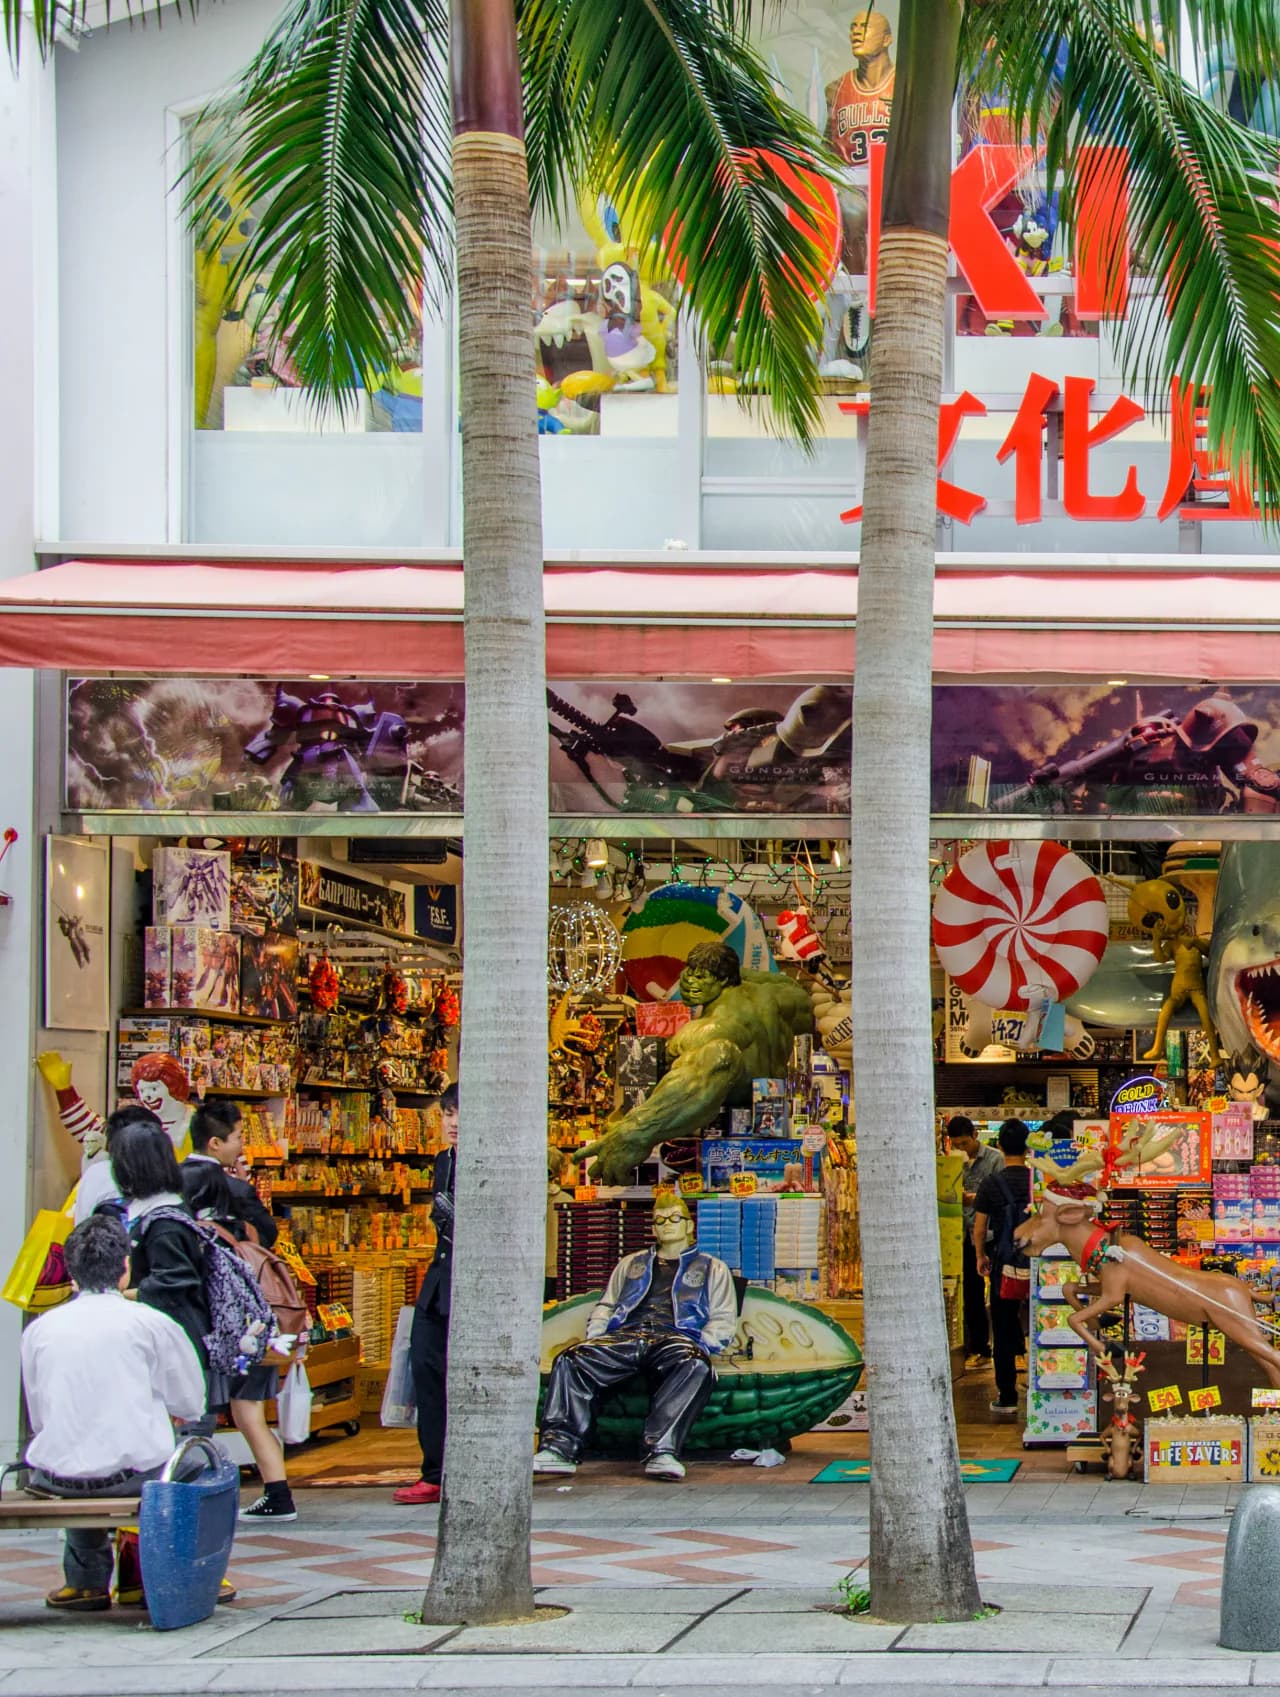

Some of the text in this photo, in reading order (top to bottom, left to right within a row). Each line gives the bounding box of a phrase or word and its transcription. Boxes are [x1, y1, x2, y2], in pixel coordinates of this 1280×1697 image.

[949, 1011, 969, 1026] M
[1118, 1083, 1155, 1103] COLD
[1114, 1099, 1158, 1112] DRINK
[1189, 1339, 1221, 1360] 56
[1153, 1446, 1239, 1463] LIFE SAVERS
